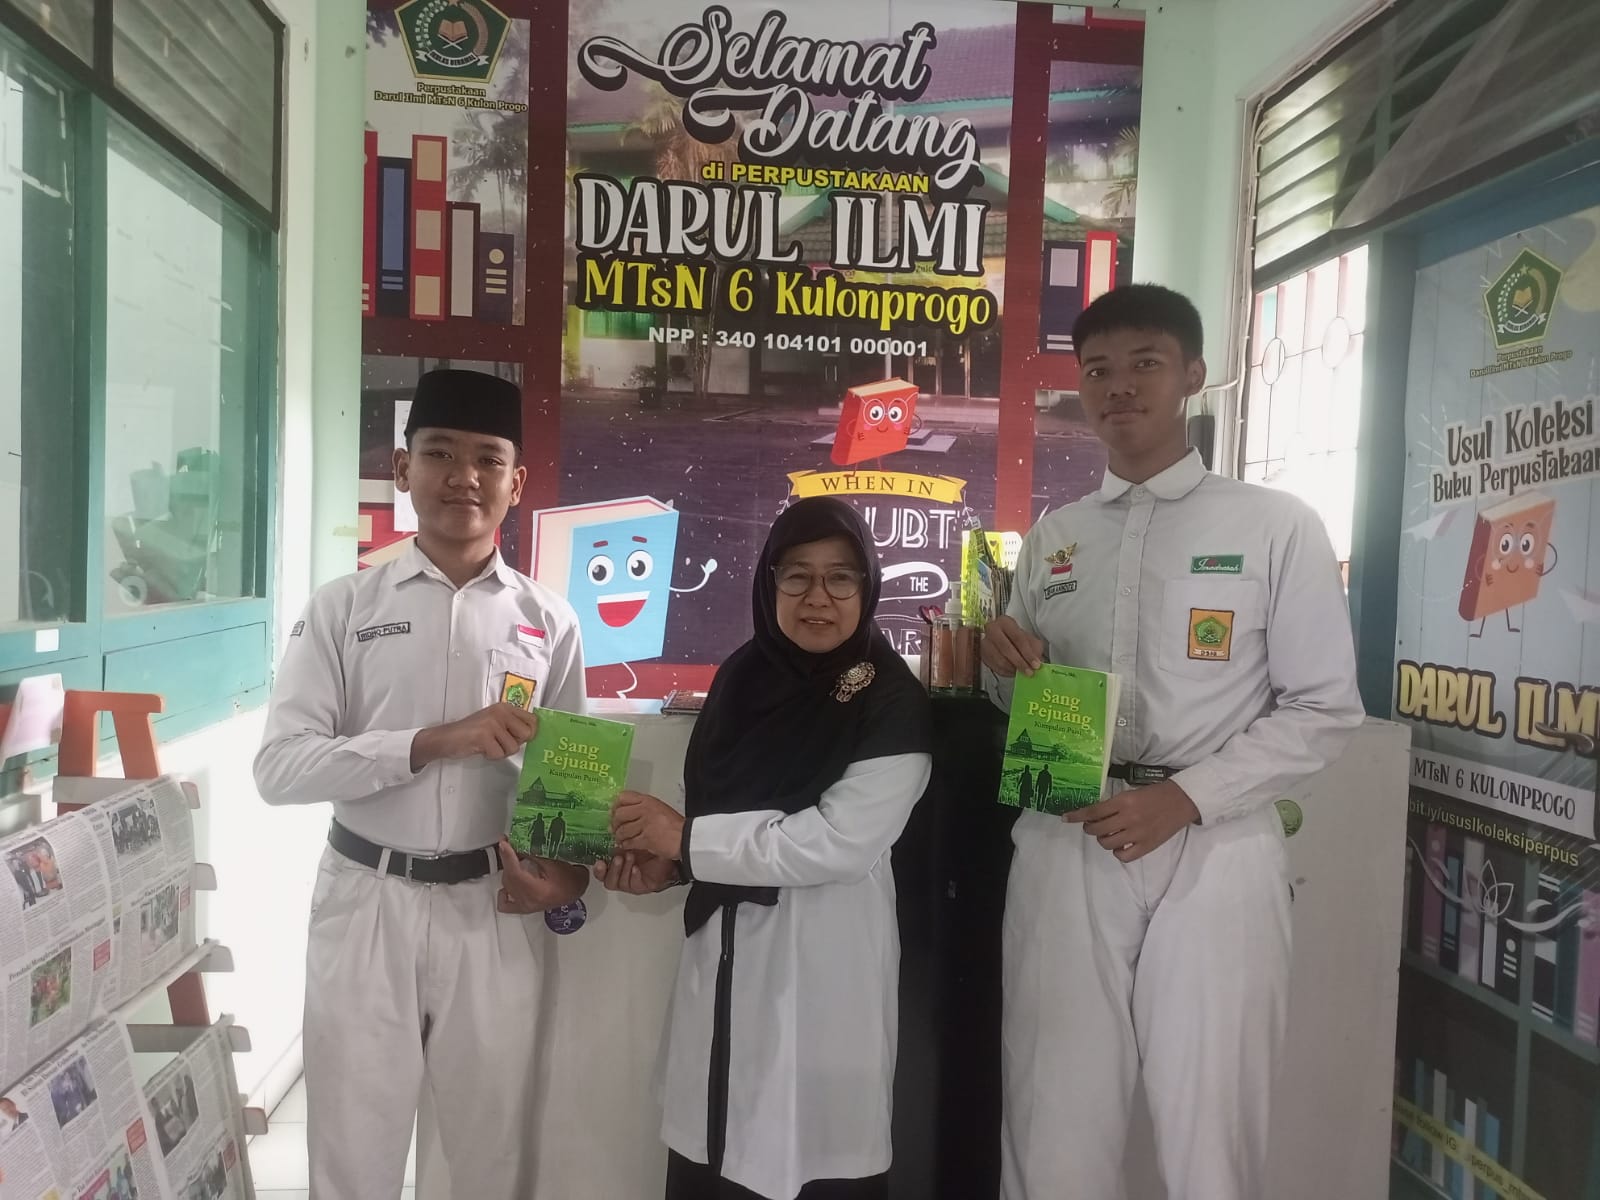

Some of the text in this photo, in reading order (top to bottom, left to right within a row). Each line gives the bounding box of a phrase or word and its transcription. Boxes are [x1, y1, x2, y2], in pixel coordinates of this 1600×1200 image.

[579, 8, 933, 94] Selamat
[375, 90, 528, 114] Darul Ilmi MTsN 6 Kulon Progo
[417, 83, 486, 98] Perpustakaan
[686, 84, 982, 189] Datang
[702, 161, 929, 193] di PERPUSTAKAAN
[576, 177, 987, 273] DARUL ILMI
[583, 257, 991, 335] MTsN 6 Kulonprogo
[649, 327, 695, 345] NPP
[715, 330, 756, 348] 340
[764, 334, 841, 353] 104101
[850, 339, 928, 358] 000001
[1448, 400, 1593, 466] Usul Koleksi
[821, 476, 935, 496] WHEN IN
[1433, 474, 1472, 502] Buku
[909, 576, 929, 593] THE
[383, 624, 407, 635] PUTRA
[1042, 688, 1081, 711] Sang
[1399, 661, 1505, 737] DARUL
[1027, 701, 1092, 729] Pejuang
[558, 737, 600, 760] Sang
[542, 749, 611, 777] Pejuang
[1414, 757, 1576, 821] MTsN 6 KULONPROGO
